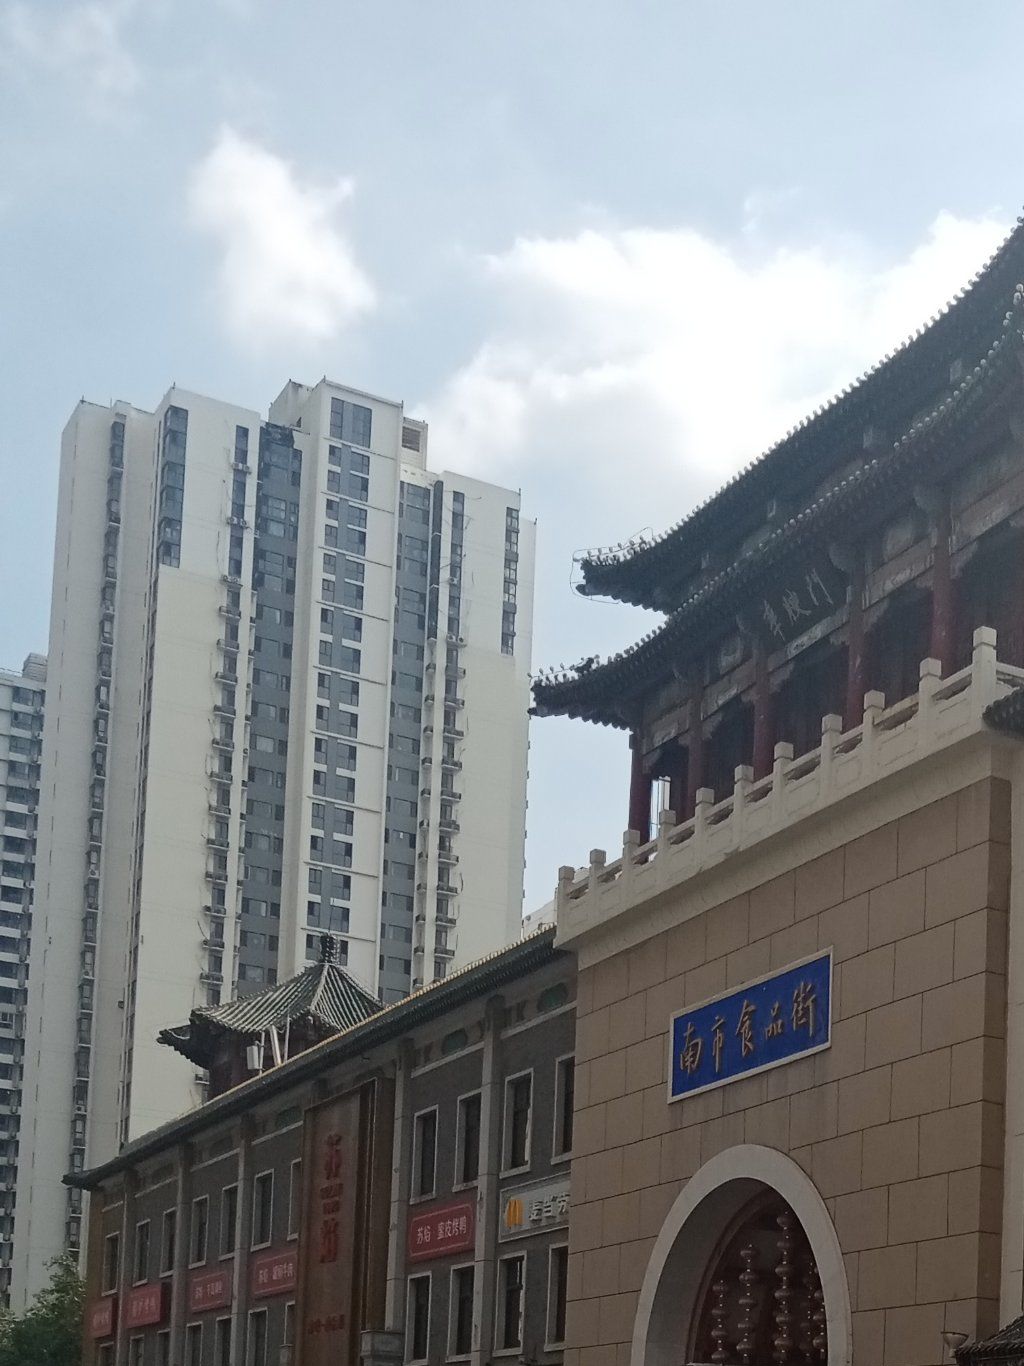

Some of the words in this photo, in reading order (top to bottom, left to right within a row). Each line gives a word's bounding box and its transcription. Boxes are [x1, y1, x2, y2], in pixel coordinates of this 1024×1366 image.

[679, 980, 818, 1075] 南市食品街
